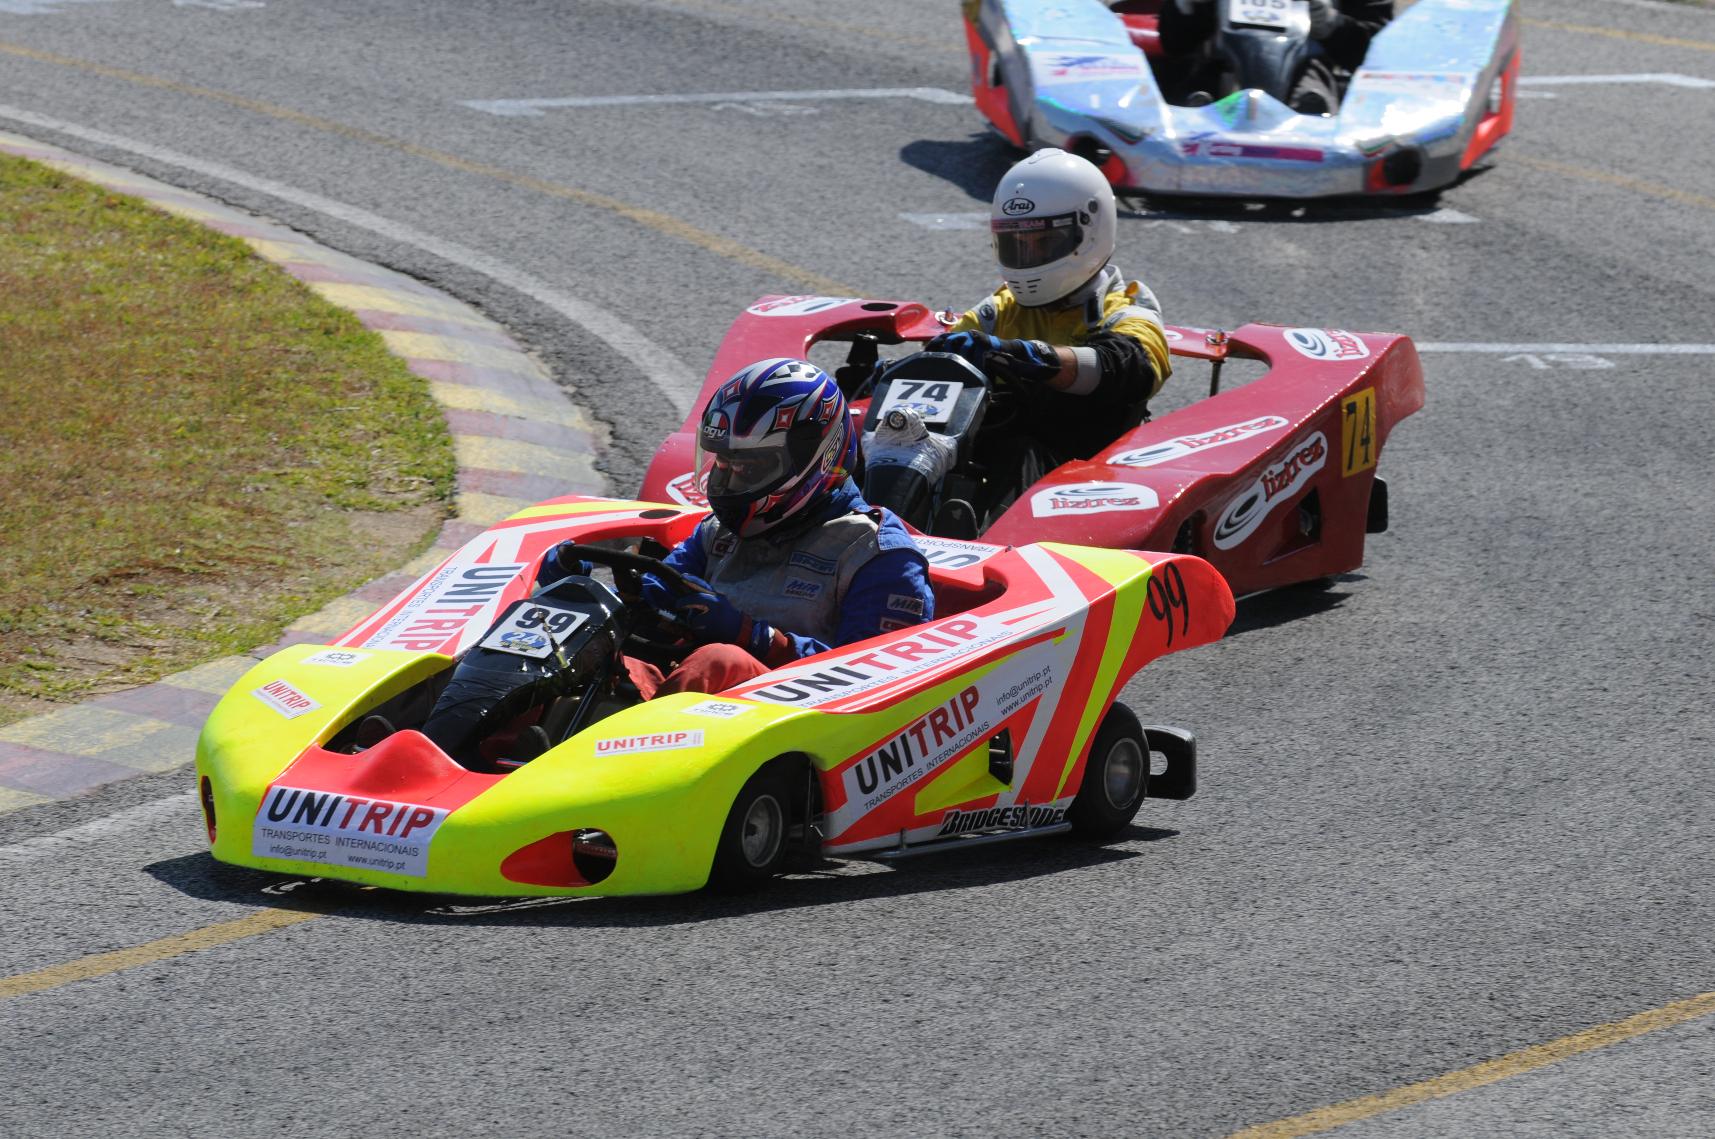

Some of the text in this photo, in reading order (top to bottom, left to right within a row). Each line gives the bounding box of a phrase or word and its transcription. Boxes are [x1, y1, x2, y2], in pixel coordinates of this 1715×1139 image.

[1005, 200, 1030, 211] Arai
[897, 381, 950, 401] 74
[1346, 396, 1370, 471] 74
[390, 565, 523, 651] UNITRIP
[515, 607, 577, 633] 99
[1147, 562, 1189, 648] 99
[754, 619, 978, 702] UNITRIP
[263, 680, 312, 708] UNITRIP
[801, 675, 898, 708] TRANSPORTES
[996, 665, 1051, 706] info@unitrip.pt
[1001, 676, 1053, 715] www.unitrip.pt
[597, 732, 688, 751] UNITRIP
[854, 685, 980, 795] UNITRIP
[864, 721, 990, 811] TRANSPORTES INTERNACIONAIS
[267, 788, 435, 838] UNITRIP
[262, 828, 420, 857] TRANSPORTES INTERNACIONAIS
[269, 845, 328, 860] info@unitrip.pt
[347, 855, 406, 871] www.unitrip.pt
